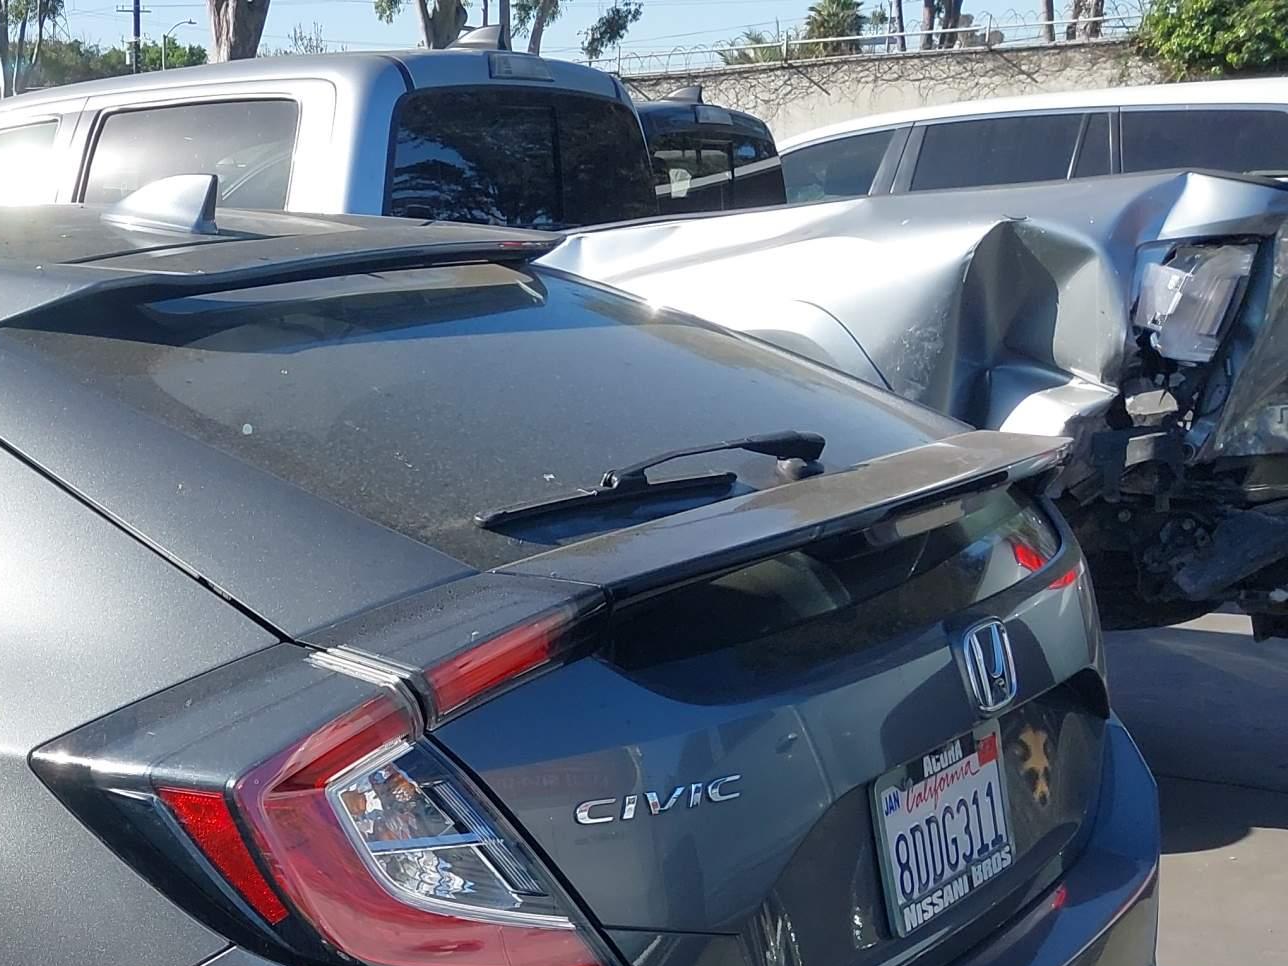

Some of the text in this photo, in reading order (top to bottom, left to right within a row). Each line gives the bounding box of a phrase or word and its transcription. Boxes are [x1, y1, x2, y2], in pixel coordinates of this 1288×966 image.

[575, 774, 742, 825] CIVIC
[884, 790, 900, 817] JAN
[906, 757, 980, 815] California
[895, 780, 1004, 900] 8DDG311
[902, 843, 1013, 933] NISSANI BROS
